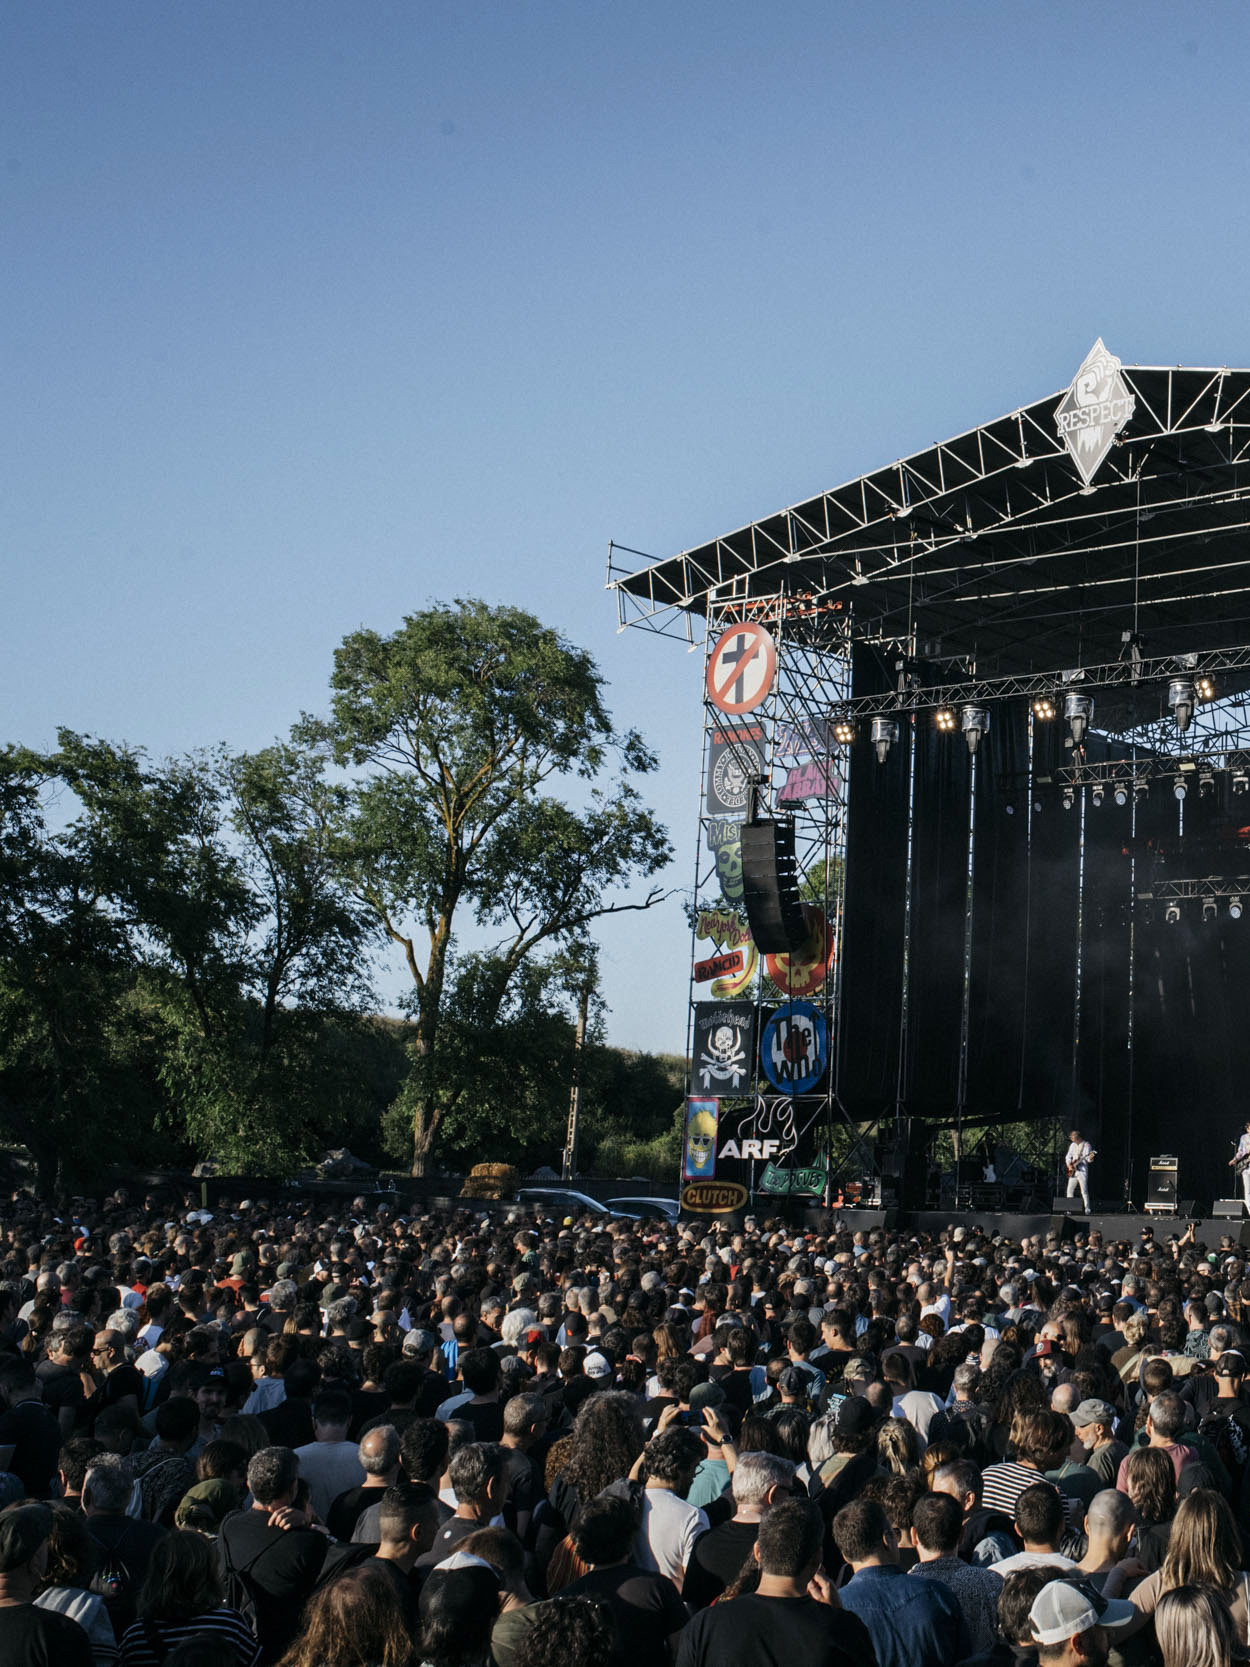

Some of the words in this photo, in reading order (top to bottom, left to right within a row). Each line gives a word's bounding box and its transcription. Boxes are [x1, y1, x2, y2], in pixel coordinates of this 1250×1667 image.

[1060, 399, 1132, 432] RESPECT
[698, 954, 741, 979] RANCID
[718, 1139, 780, 1160] ARF
[687, 1189, 739, 1205] CLUTCH
